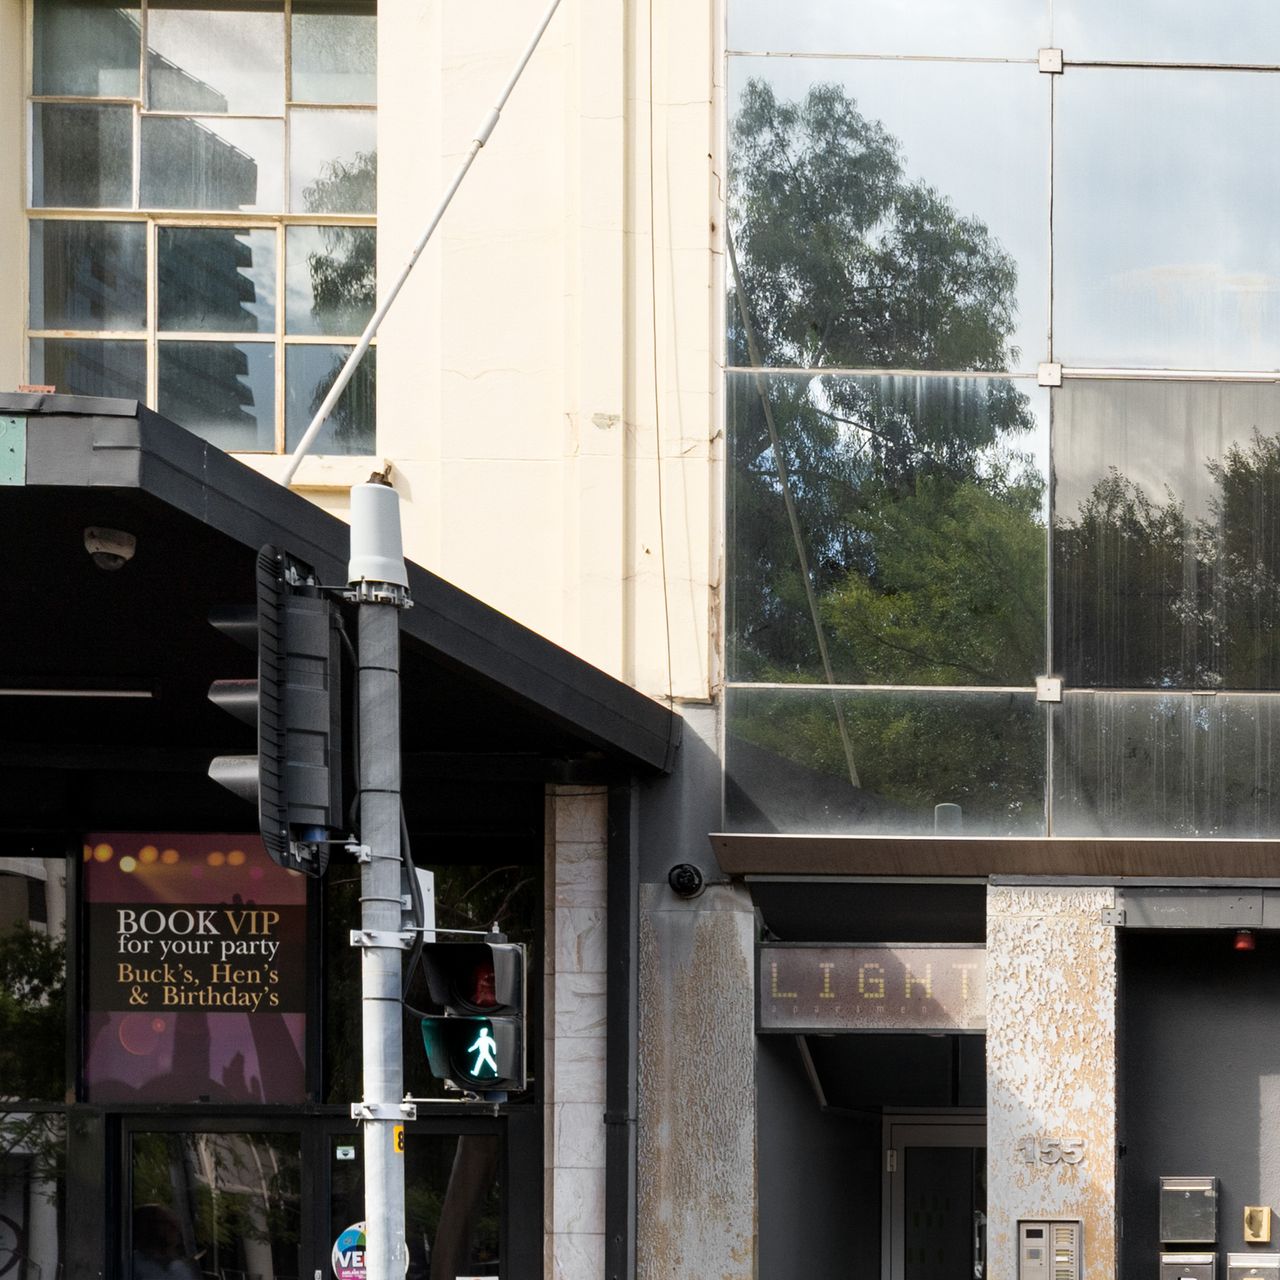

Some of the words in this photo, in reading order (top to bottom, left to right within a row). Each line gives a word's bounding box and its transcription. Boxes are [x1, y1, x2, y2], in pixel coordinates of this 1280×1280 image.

[116, 909, 221, 935] BOOK
[224, 910, 280, 935] VIP
[118, 934, 153, 953] for
[159, 939, 213, 960] your
[220, 939, 280, 961] party
[117, 963, 200, 986] Buck's,
[211, 964, 279, 984] Hen's
[771, 962, 979, 999] LIGHT
[129, 985, 149, 1005] &
[162, 985, 279, 1012] Birthday's
[1016, 1136, 1085, 1165] 155
